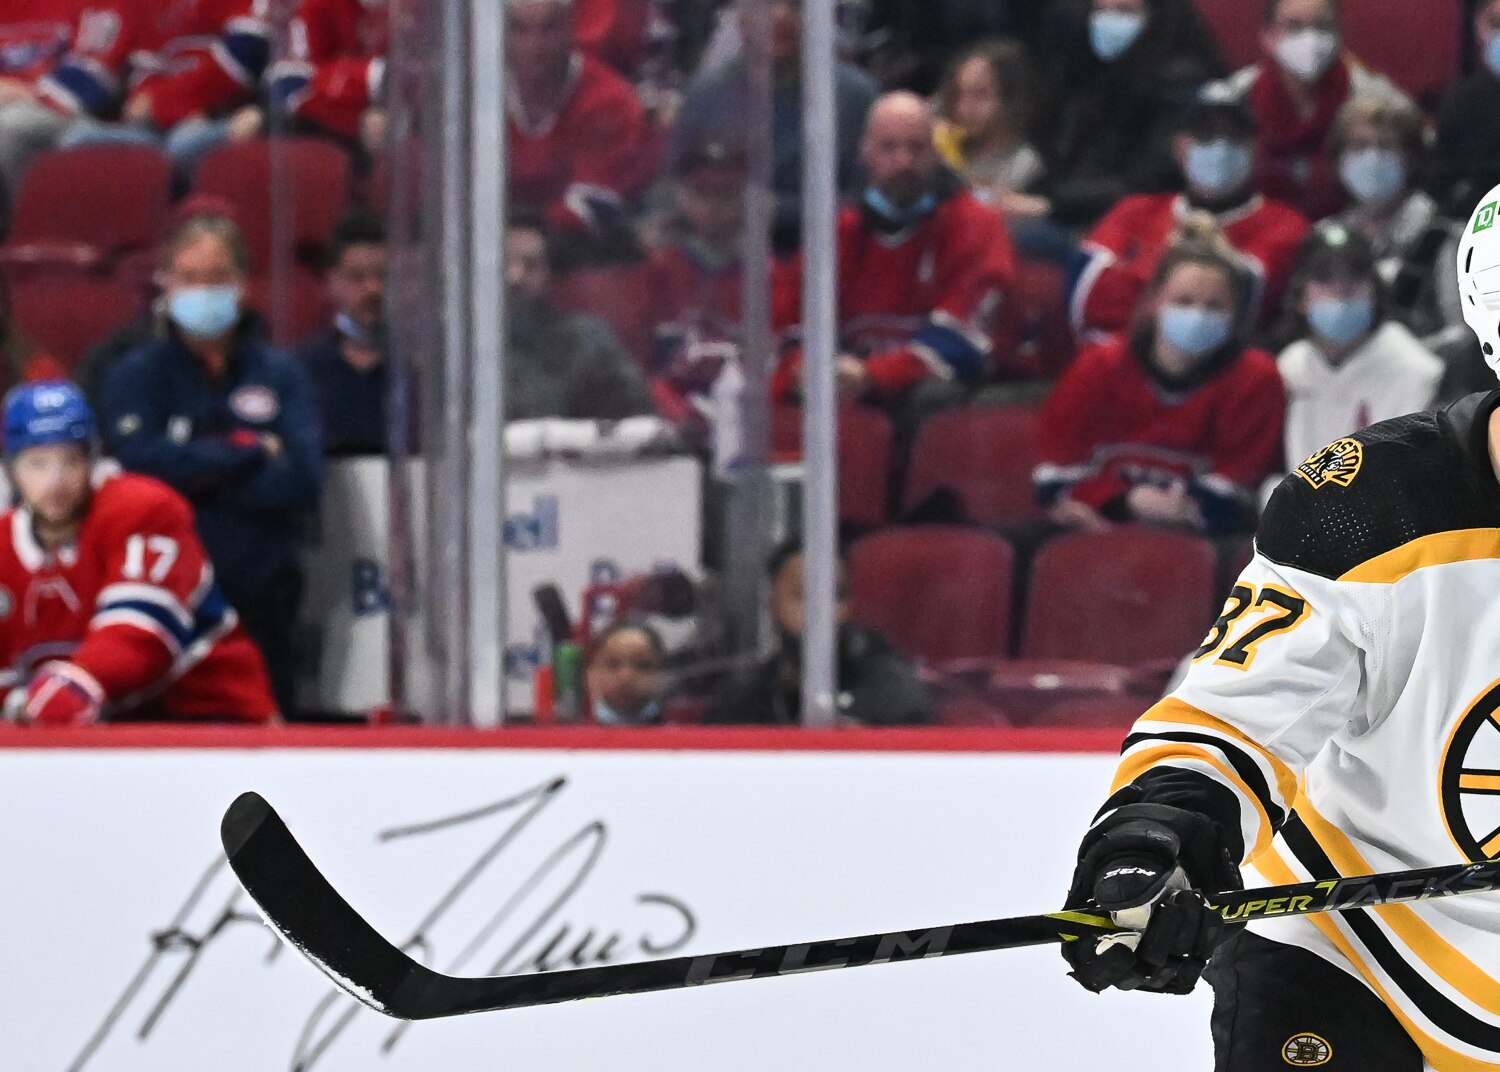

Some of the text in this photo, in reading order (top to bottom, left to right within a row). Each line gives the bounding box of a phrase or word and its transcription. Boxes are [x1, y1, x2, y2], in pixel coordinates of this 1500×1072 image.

[122, 534, 179, 583] 17
[1209, 895, 1314, 920] UPER
[684, 926, 955, 988] CCM
